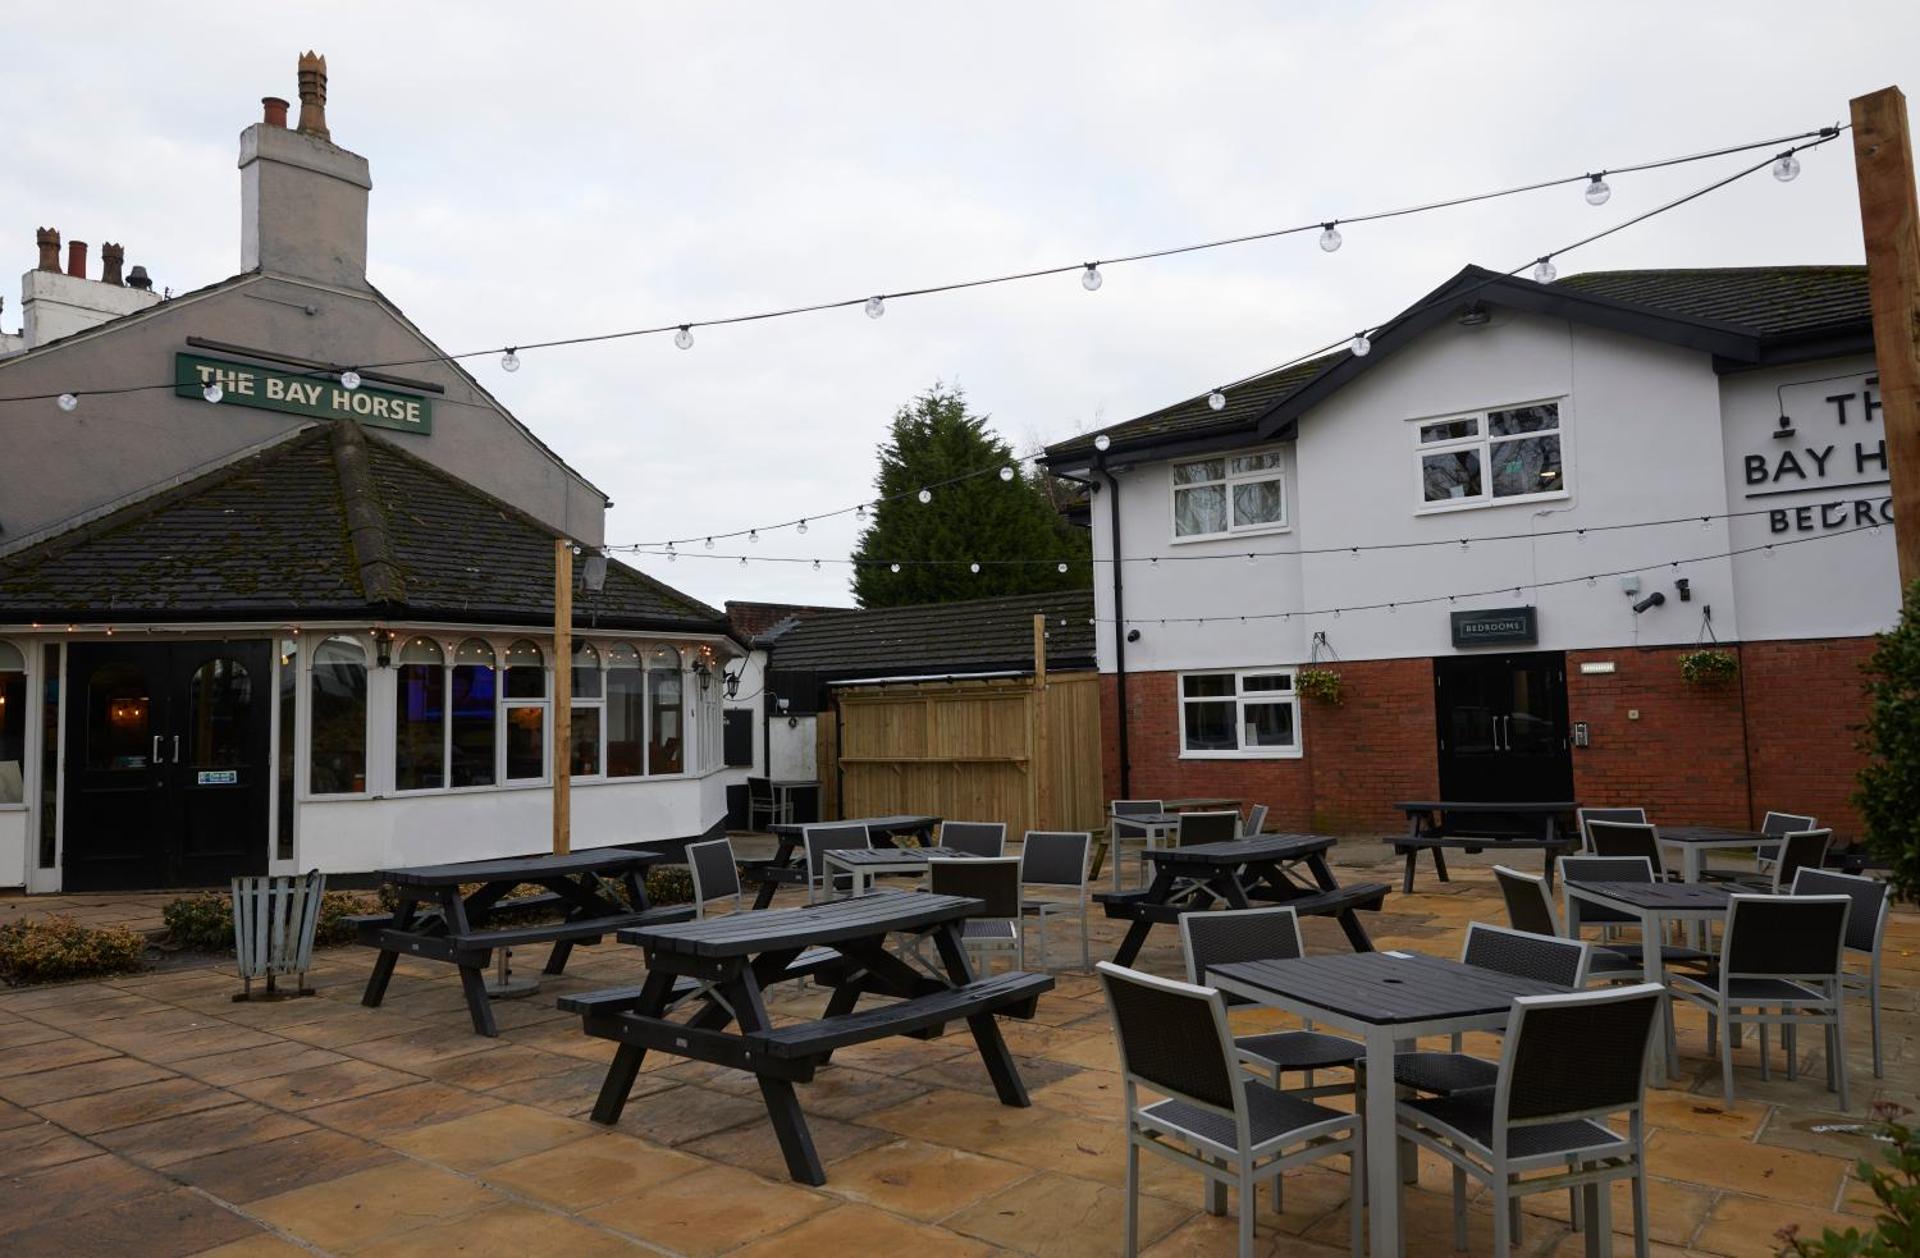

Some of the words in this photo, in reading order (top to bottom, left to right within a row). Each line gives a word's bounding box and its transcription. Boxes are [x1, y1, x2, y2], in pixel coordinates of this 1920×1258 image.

[196, 364, 254, 395] THE
[266, 377, 323, 406] BAY
[332, 389, 421, 424] HORSE
[1744, 445, 1835, 486] BAY
[1466, 621, 1520, 633] BEDROOMS
